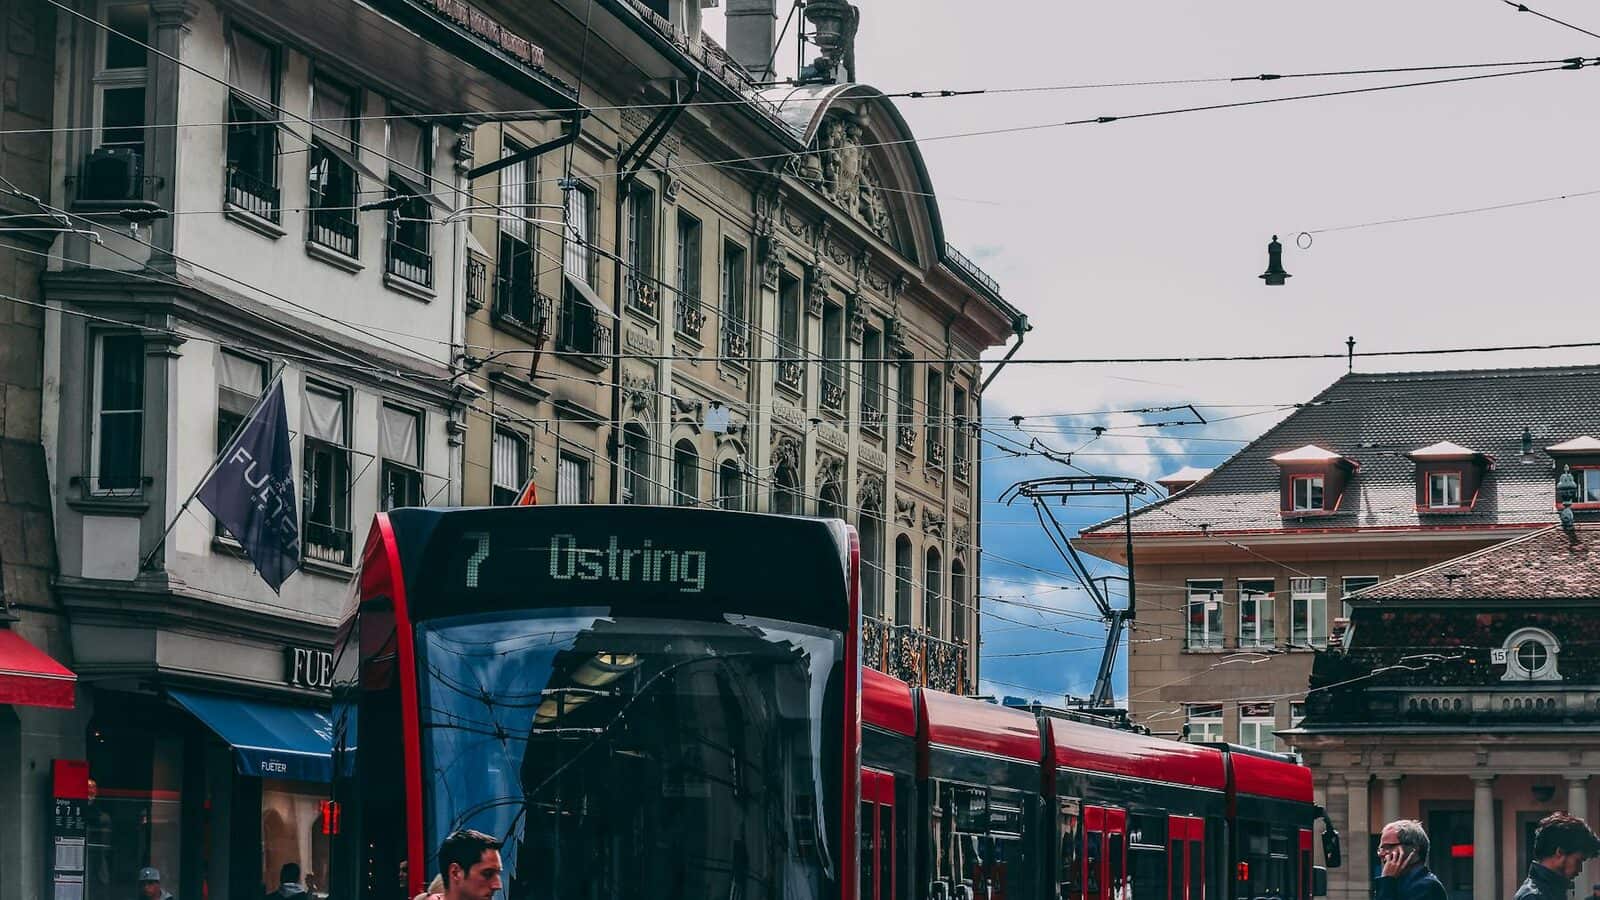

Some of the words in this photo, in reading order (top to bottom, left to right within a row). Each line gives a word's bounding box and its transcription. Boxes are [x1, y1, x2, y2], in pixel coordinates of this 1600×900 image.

[463, 531, 490, 588] 7
[550, 534, 706, 592] Ostring
[1494, 651, 1504, 661] 15
[261, 761, 287, 772] FUETER
